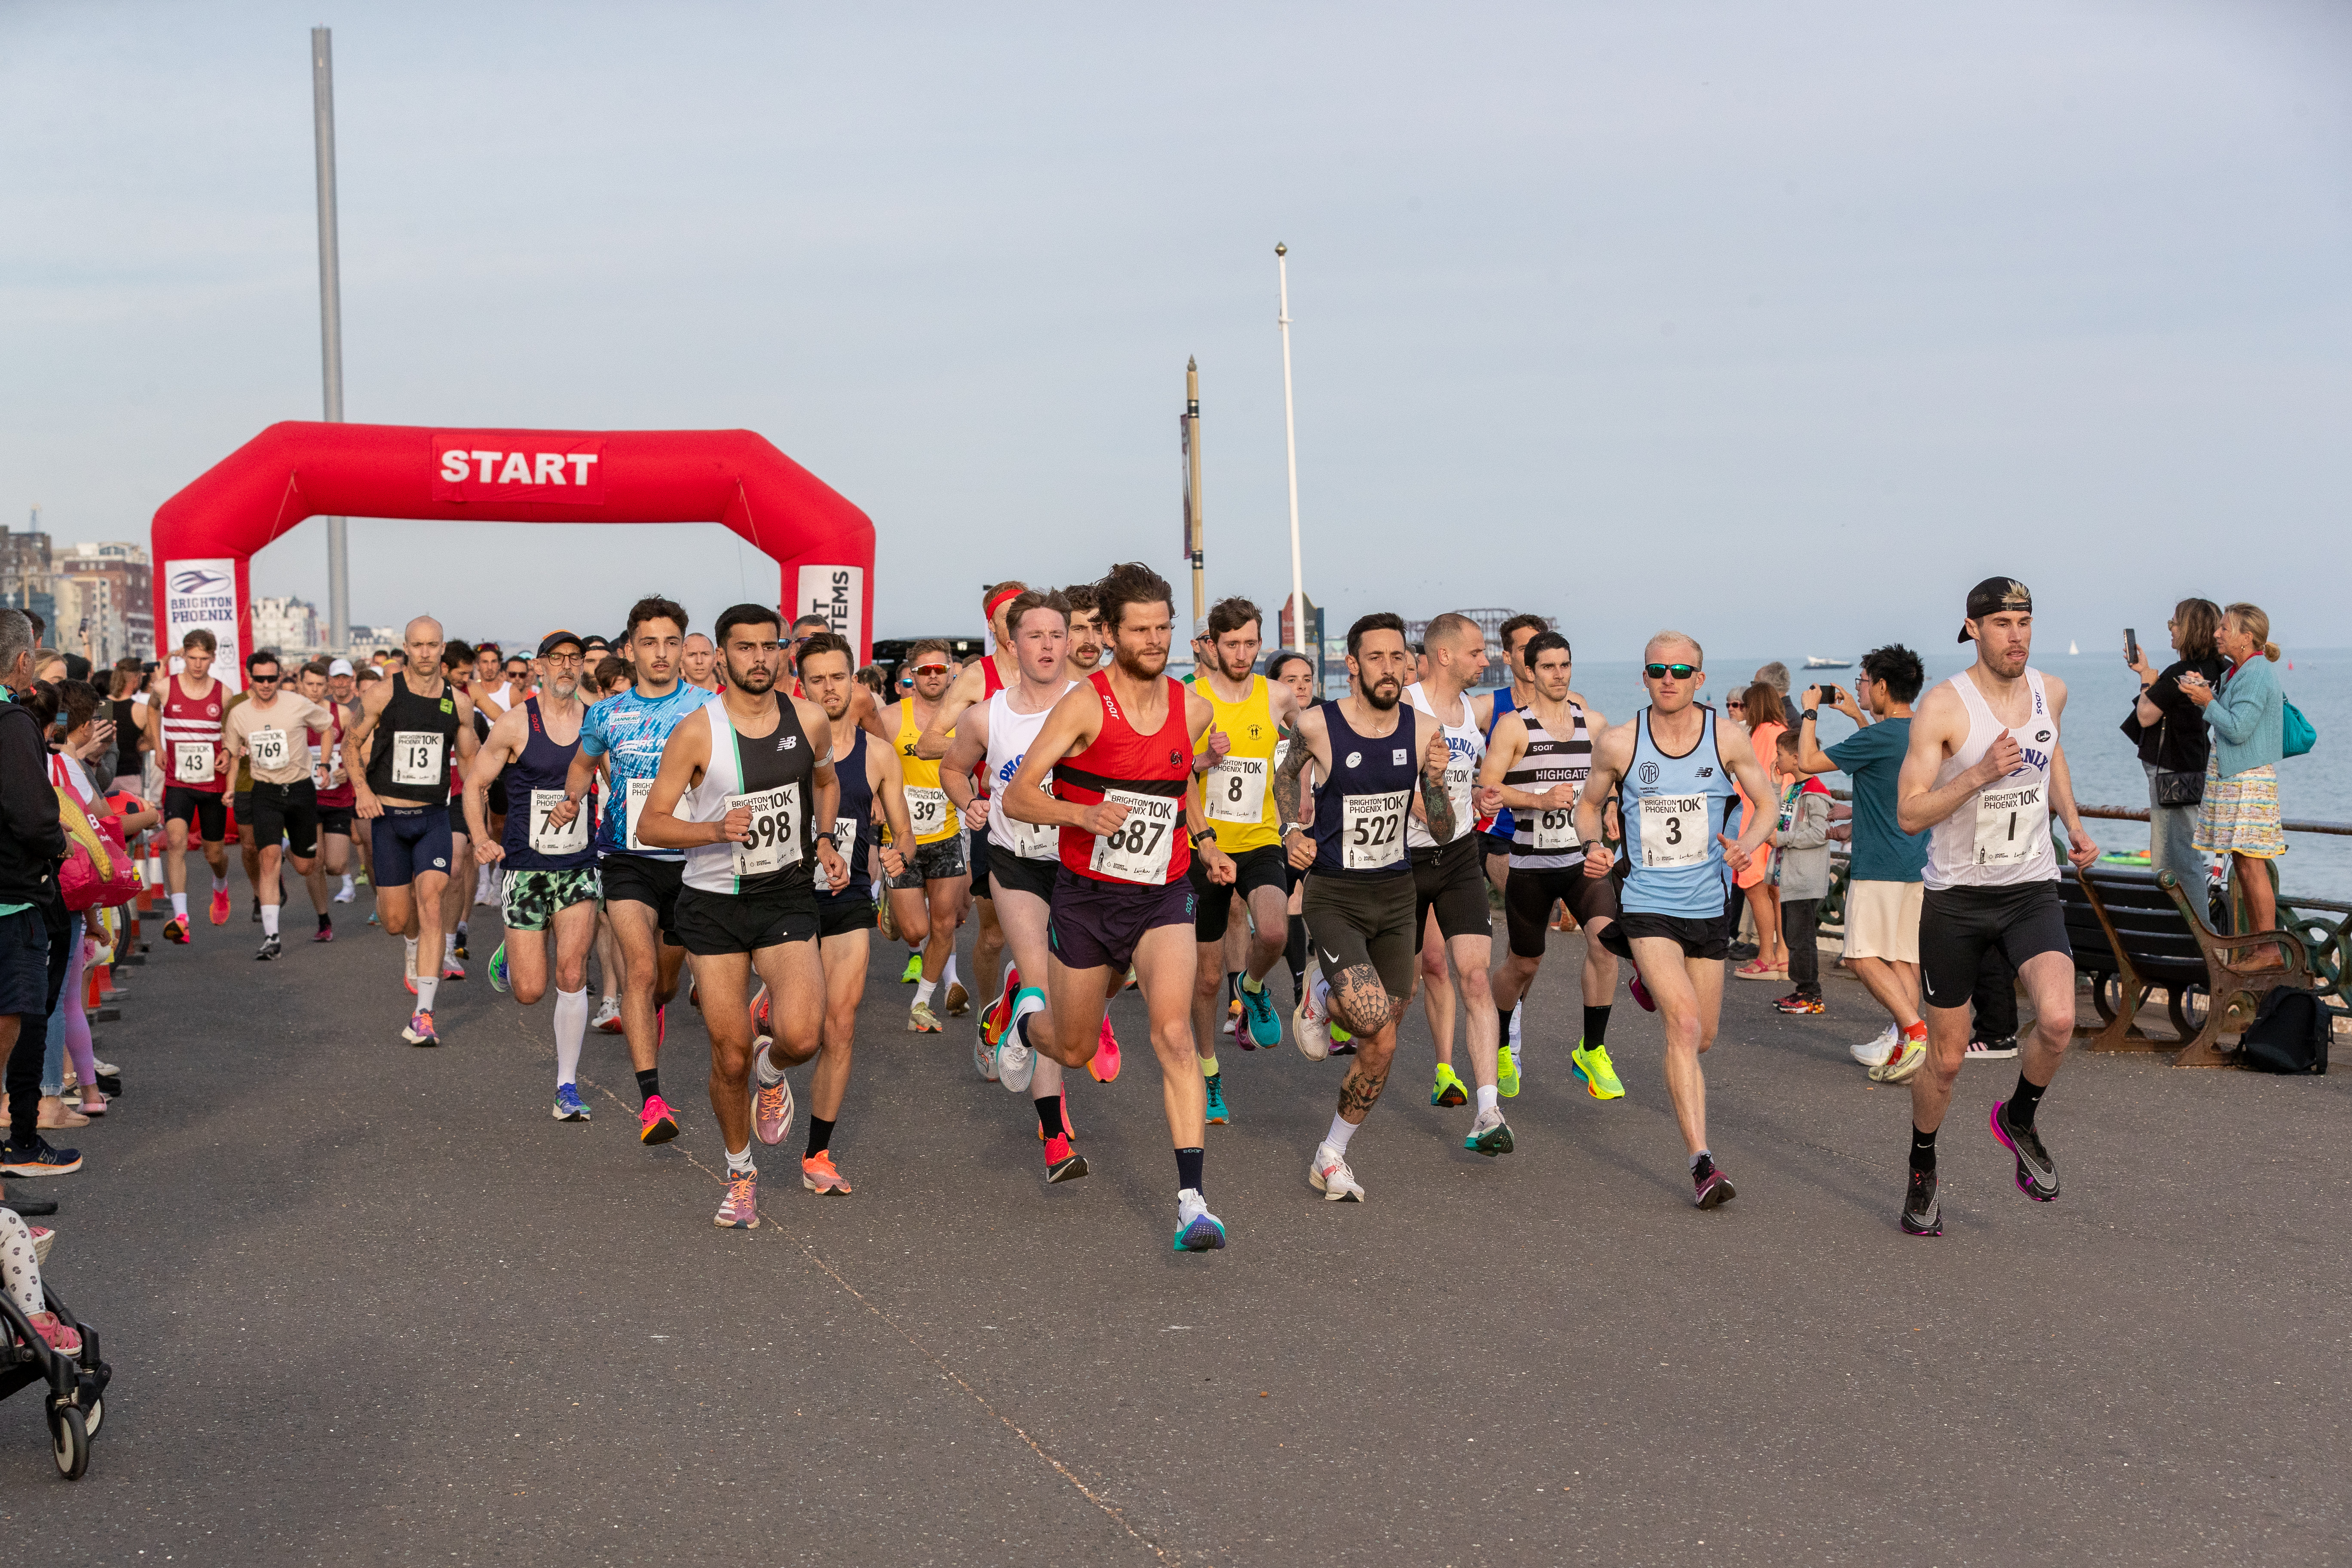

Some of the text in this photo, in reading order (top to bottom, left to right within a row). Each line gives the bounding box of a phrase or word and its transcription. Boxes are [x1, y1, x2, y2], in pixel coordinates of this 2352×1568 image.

[440, 449, 598, 486] START
[171, 596, 232, 610] BRIGHTON
[831, 571, 848, 642] TEMS
[172, 609, 233, 623] PHOENIX
[1103, 695, 1120, 720] soar
[2034, 688, 2043, 715] soar
[531, 714, 541, 733] soar
[421, 735, 438, 745] 10K
[255, 742, 281, 758] 769
[409, 747, 428, 768] 13
[185, 755, 202, 770] 43
[1243, 762, 1262, 774] 10K
[1453, 770, 1469, 783] 10K
[1536, 769, 1588, 780] HIGHGATE
[929, 791, 945, 800] 10K
[1228, 776, 1243, 802] 8
[1984, 792, 2018, 802] BRIGHTON
[2018, 787, 2040, 806] 10K
[732, 796, 768, 807] BRIGHTON
[768, 789, 793, 809] 10K
[1111, 795, 1148, 807] BRIGHTON
[1349, 798, 1382, 806] BRIGHTON
[1382, 795, 1405, 811] 10K
[1677, 797, 1701, 813] 10K
[1984, 799, 2018, 809] PHOENIX
[913, 801, 935, 821] 39
[1148, 801, 1172, 820] 10K
[1350, 805, 1382, 813] PHOENIX
[1353, 814, 1399, 846] 522
[1666, 817, 1682, 845] 3
[2008, 811, 2017, 841] 1
[1107, 820, 1167, 856] 687
[1185, 893, 1194, 916] soar
